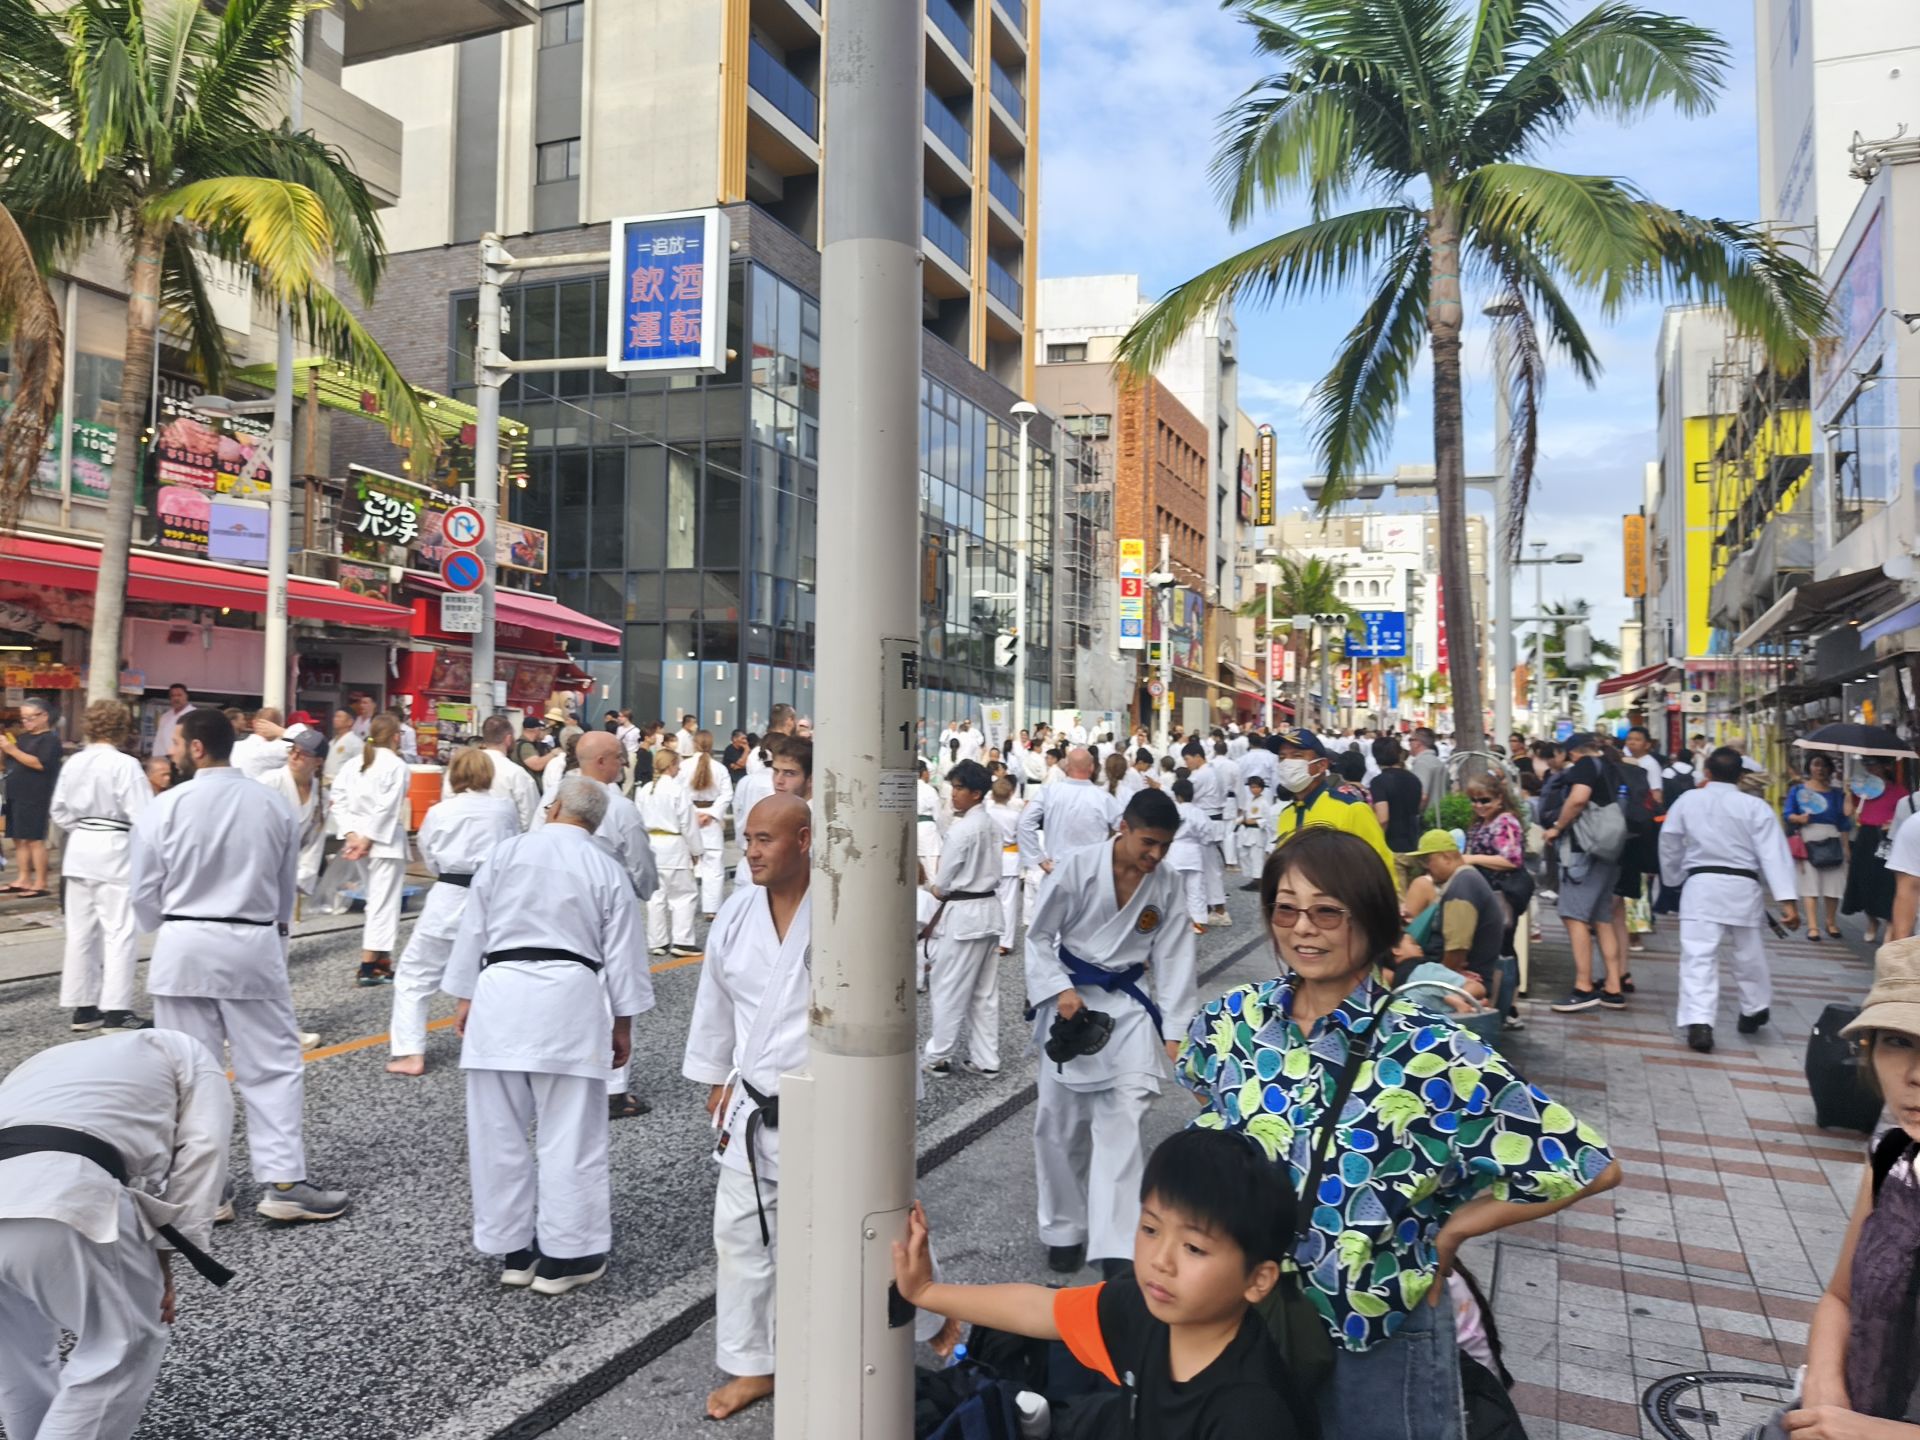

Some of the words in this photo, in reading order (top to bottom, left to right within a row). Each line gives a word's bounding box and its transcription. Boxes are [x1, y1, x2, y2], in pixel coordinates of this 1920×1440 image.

[631, 264, 703, 303] 飲酒
[629, 309, 703, 348] 運転
[364, 490, 417, 523] ごりら
[357, 514, 418, 544] パンチ
[1126, 580, 1137, 596] 3
